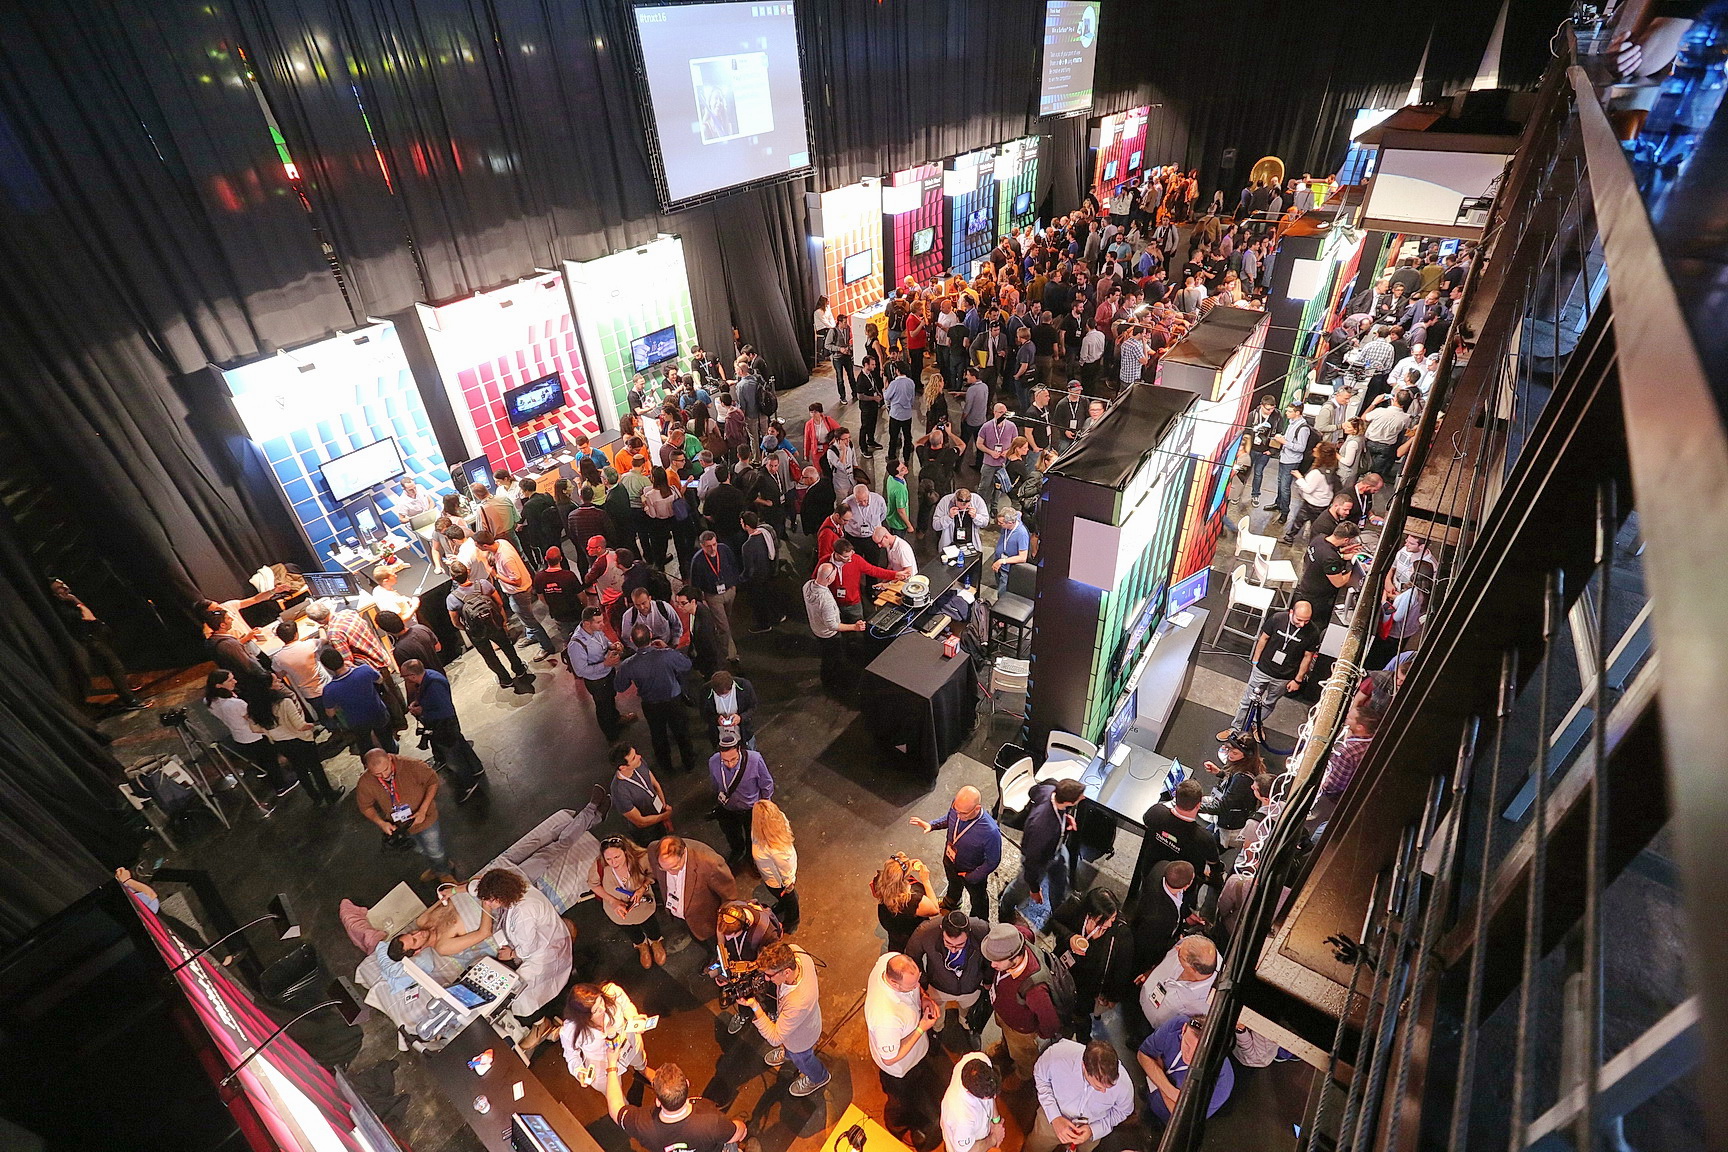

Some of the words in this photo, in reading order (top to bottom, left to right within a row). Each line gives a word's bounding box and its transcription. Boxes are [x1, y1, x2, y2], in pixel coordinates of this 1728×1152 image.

[1155, 832, 1169, 844] Think
[1169, 841, 1181, 851] Next
[882, 1045, 895, 1053] CU
[958, 1137, 970, 1147] CU
